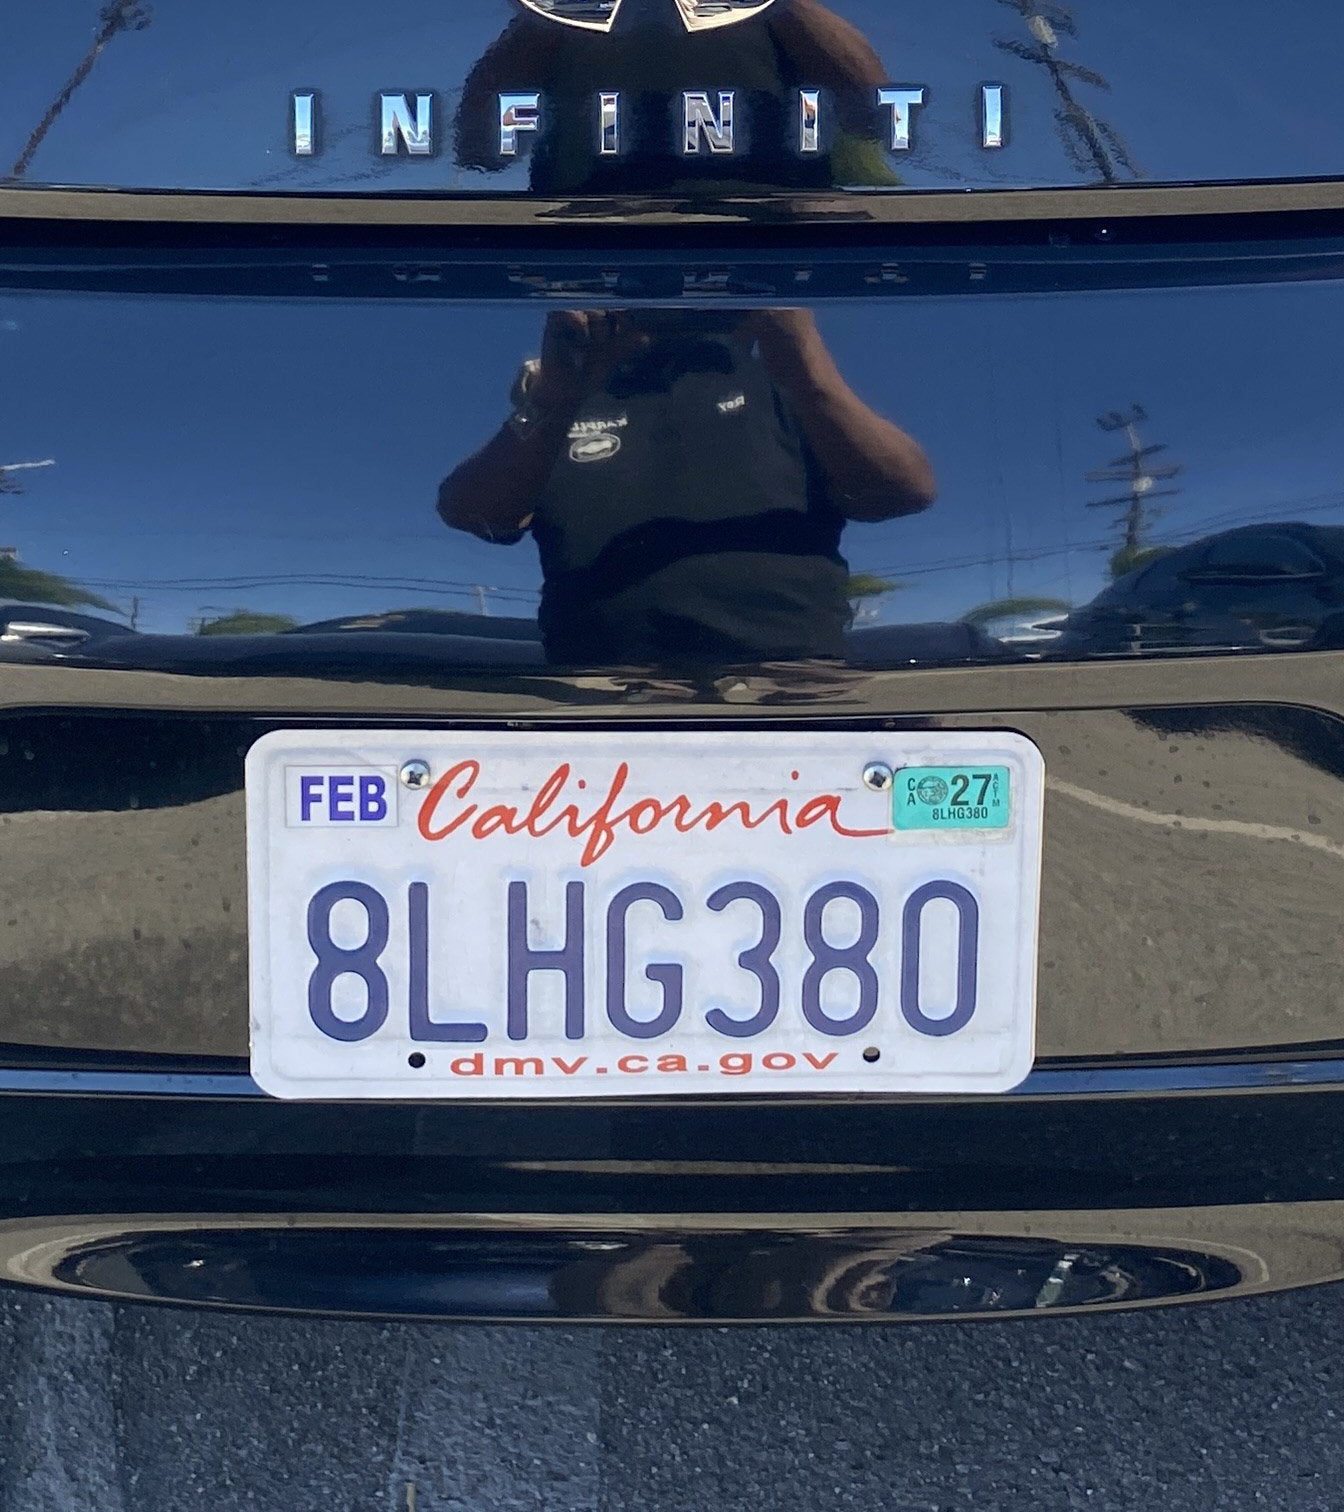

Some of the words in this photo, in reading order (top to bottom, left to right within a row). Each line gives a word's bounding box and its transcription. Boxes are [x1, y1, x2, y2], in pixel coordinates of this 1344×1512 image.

[293, 84, 1003, 155] INFINITI
[299, 774, 389, 822] FEB
[416, 760, 895, 868] California
[932, 807, 988, 821] 8LHG380
[950, 774, 992, 806] 27
[306, 879, 981, 1042] 8LHG380
[450, 1051, 839, 1077] dmv.ca.gov
